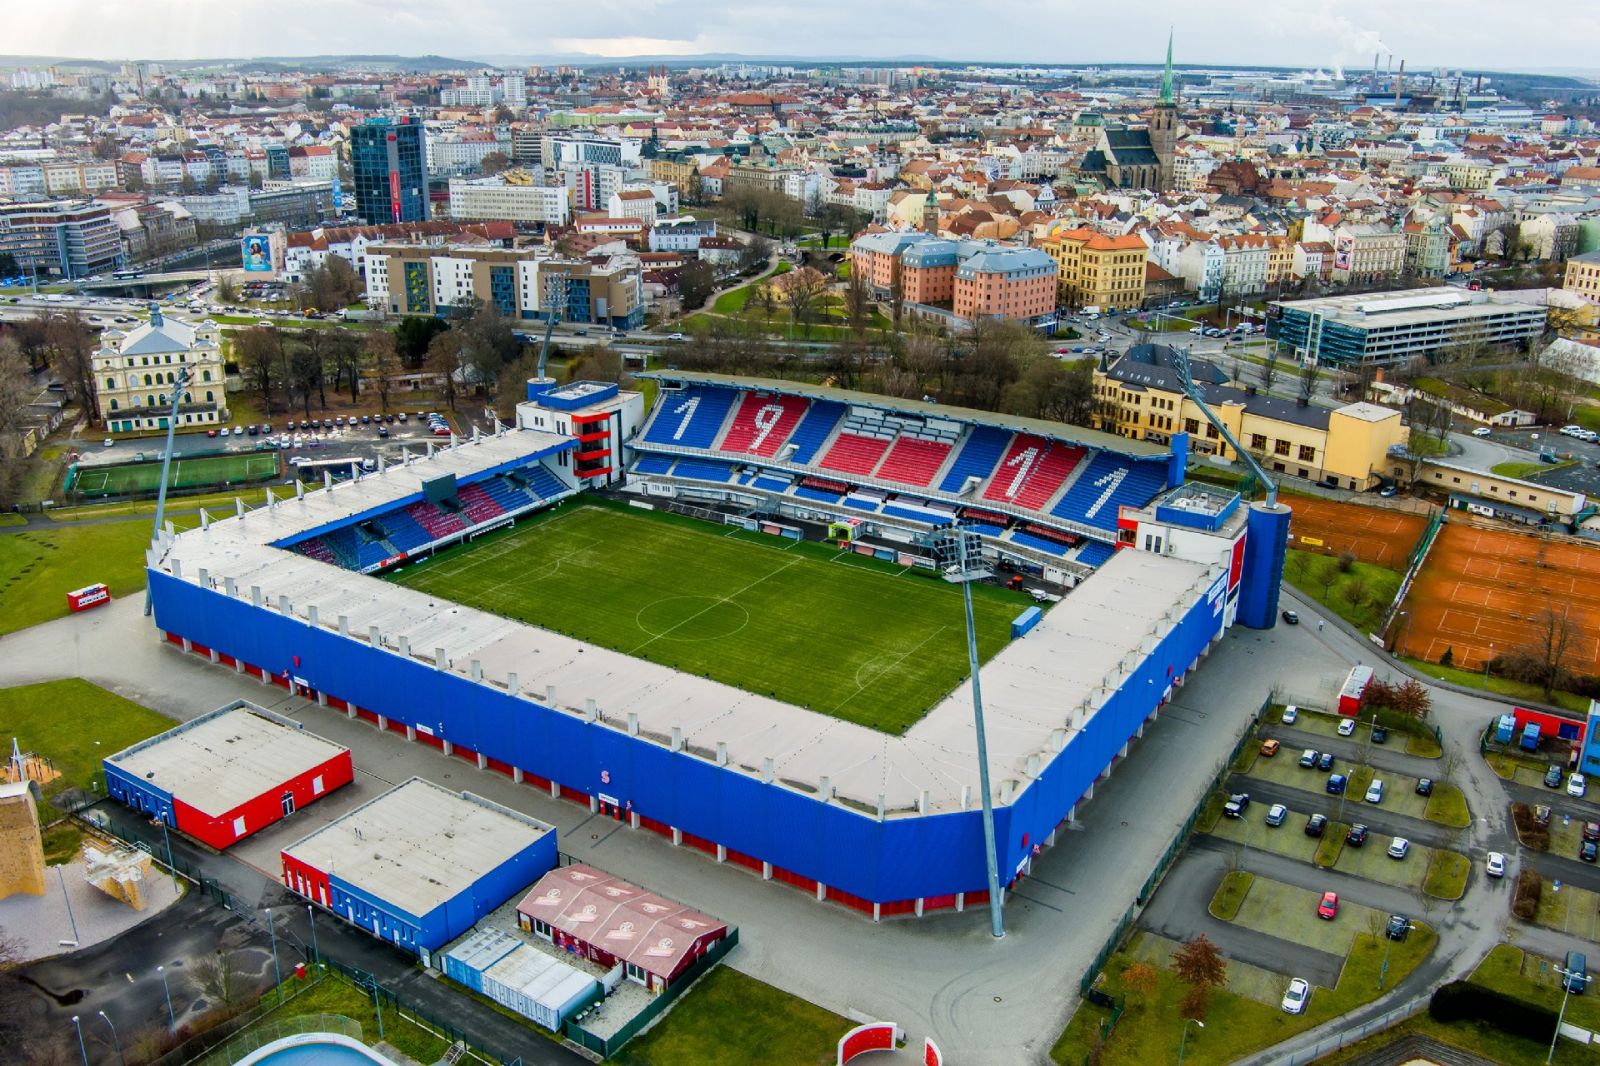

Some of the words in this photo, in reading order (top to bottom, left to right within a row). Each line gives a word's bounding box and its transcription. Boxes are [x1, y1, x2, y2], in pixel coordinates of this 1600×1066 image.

[673, 397, 701, 440] 1
[750, 404, 785, 450] 9
[1005, 446, 1039, 497] 1
[1084, 467, 1129, 519] 1
